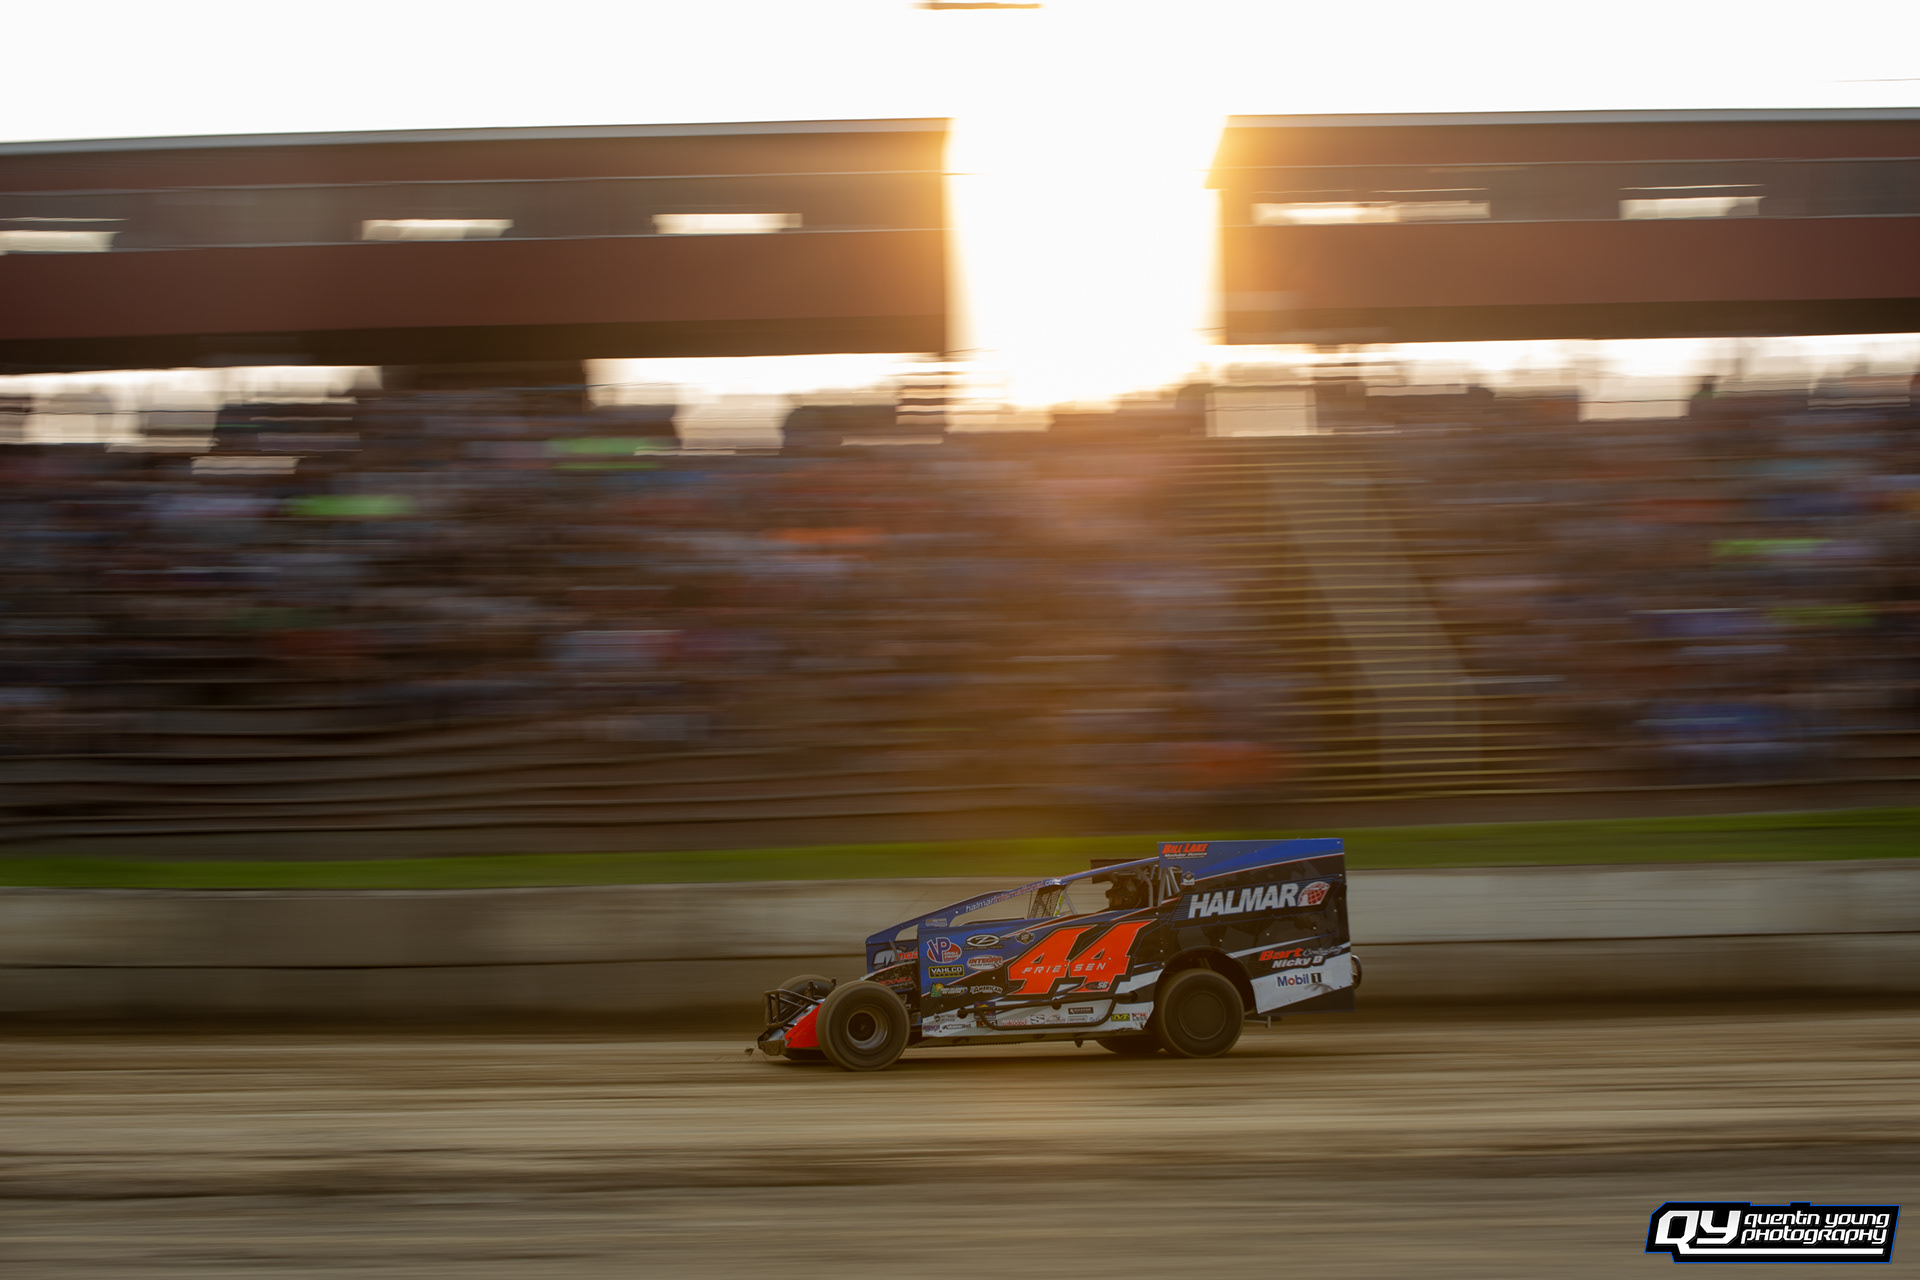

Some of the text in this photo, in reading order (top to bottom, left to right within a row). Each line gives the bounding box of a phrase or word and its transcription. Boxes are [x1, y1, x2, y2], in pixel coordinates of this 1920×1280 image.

[1188, 883, 1299, 919] HALMAR
[927, 937, 951, 963] VP
[1007, 918, 1158, 995] 44
[1259, 948, 1304, 961] Bart
[1312, 956, 1323, 964] D
[930, 966, 962, 974] VAHLCO
[1022, 962, 1106, 974] FRIESEN
[1277, 973, 1310, 987] Mobil
